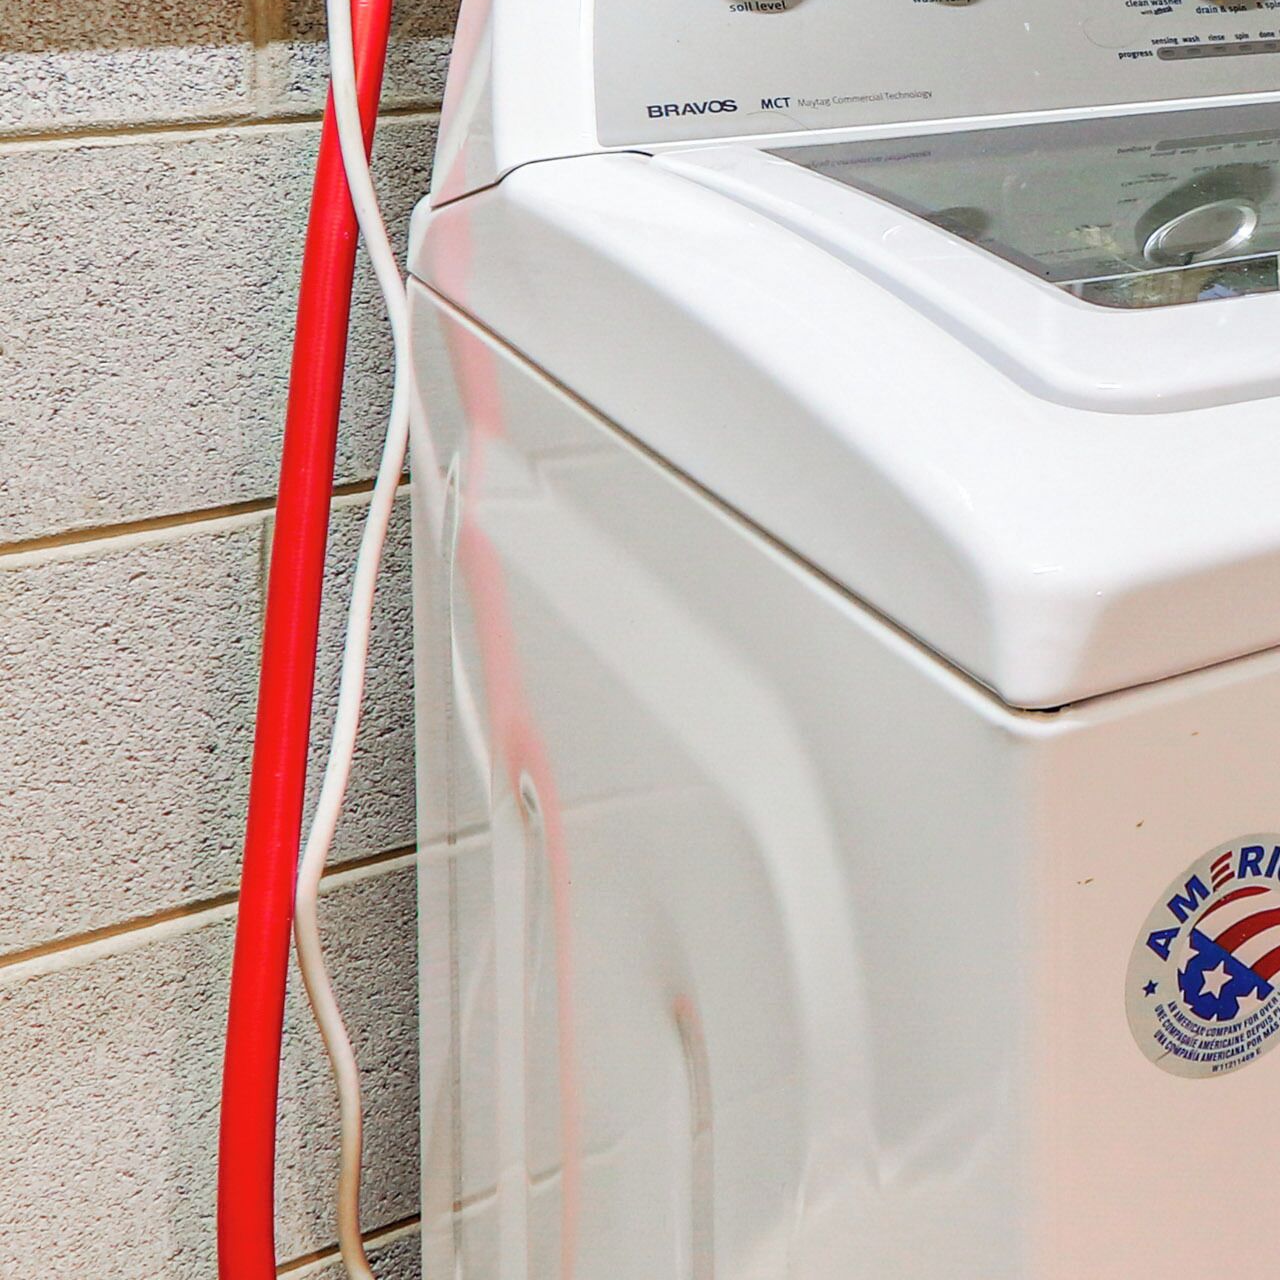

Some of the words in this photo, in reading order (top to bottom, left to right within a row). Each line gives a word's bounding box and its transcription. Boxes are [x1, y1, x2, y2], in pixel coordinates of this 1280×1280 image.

[729, 2, 753, 13] soil
[755, 0, 787, 11] level
[1125, 0, 1149, 7] clean
[1195, 5, 1218, 14] drain
[1228, 4, 1248, 14] spin
[1151, 37, 1179, 45] sensing
[1208, 33, 1225, 41] rinse
[1117, 50, 1154, 60] progress
[647, 99, 739, 119] BRAVOS
[760, 97, 790, 109] MCT
[798, 99, 831, 110] Maytag
[832, 92, 883, 105] Commercial
[885, 89, 933, 101] Technology
[1243, 1014, 1259, 1028] FOR
[1259, 996, 1278, 1017] OVER
[1246, 1014, 1274, 1039] DEPUIS
[1247, 1035, 1263, 1049] POR
